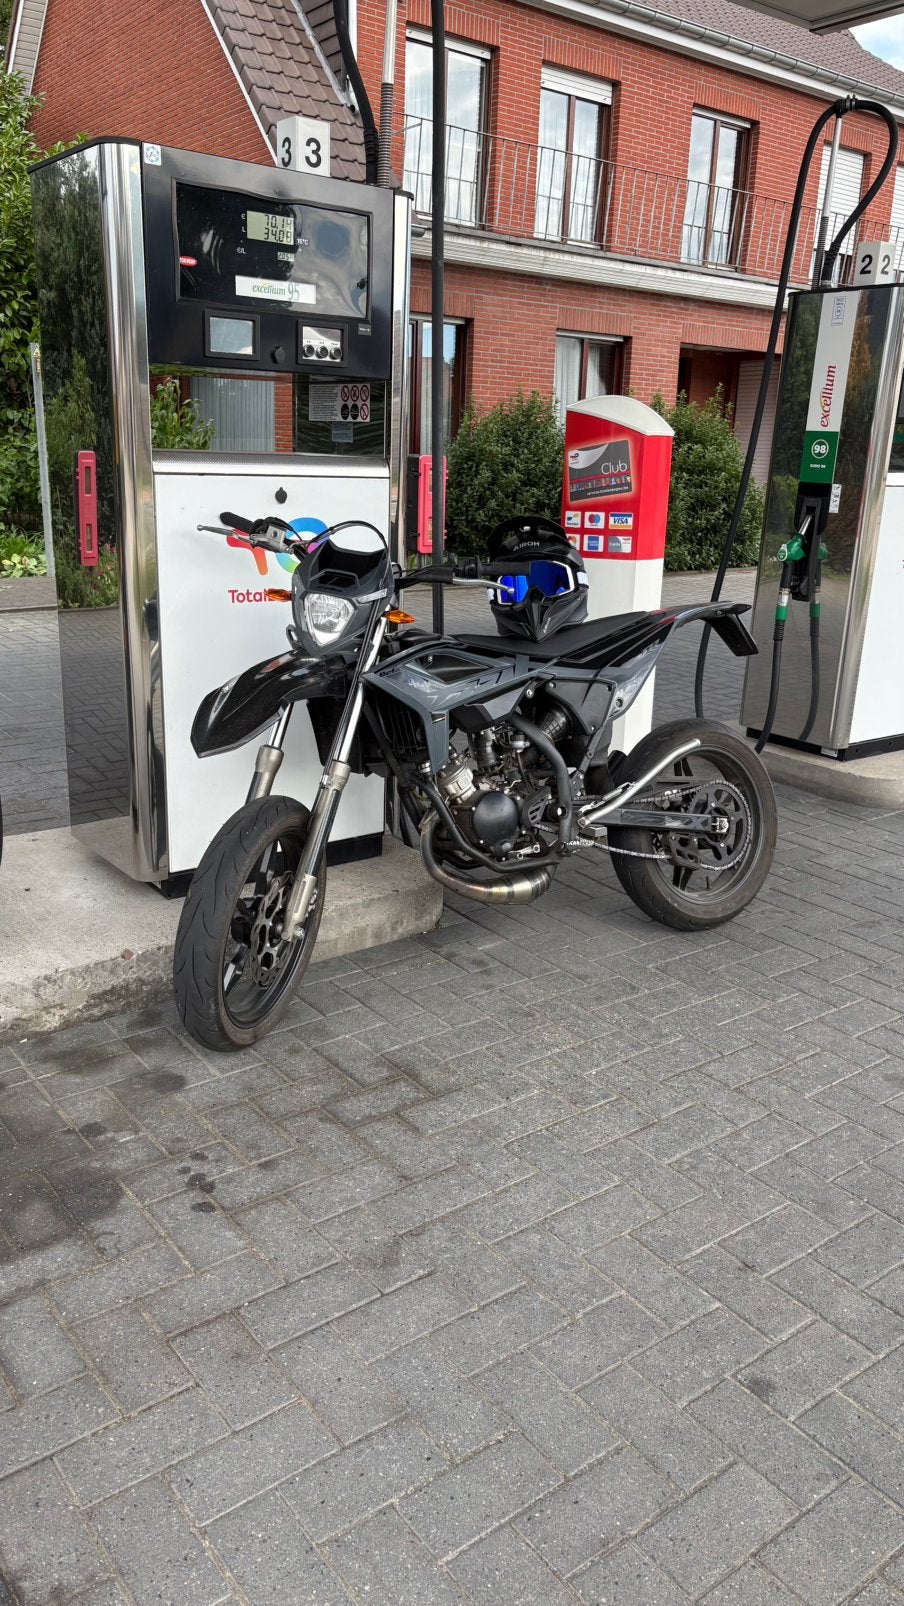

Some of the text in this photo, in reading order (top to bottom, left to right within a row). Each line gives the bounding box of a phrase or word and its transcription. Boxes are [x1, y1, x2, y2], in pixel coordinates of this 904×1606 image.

[282, 137, 291, 167] 3
[305, 138, 321, 167] 3
[264, 227, 292, 243] 34.08
[860, 254, 872, 274] 2
[881, 254, 891, 275] 2
[252, 281, 300, 302] excellium 95
[820, 364, 837, 428] excellium
[813, 444, 827, 454] 98
[600, 460, 628, 475] Club
[613, 517, 629, 525] VISA
[513, 541, 540, 552] AIROH
[227, 588, 276, 604] Total
